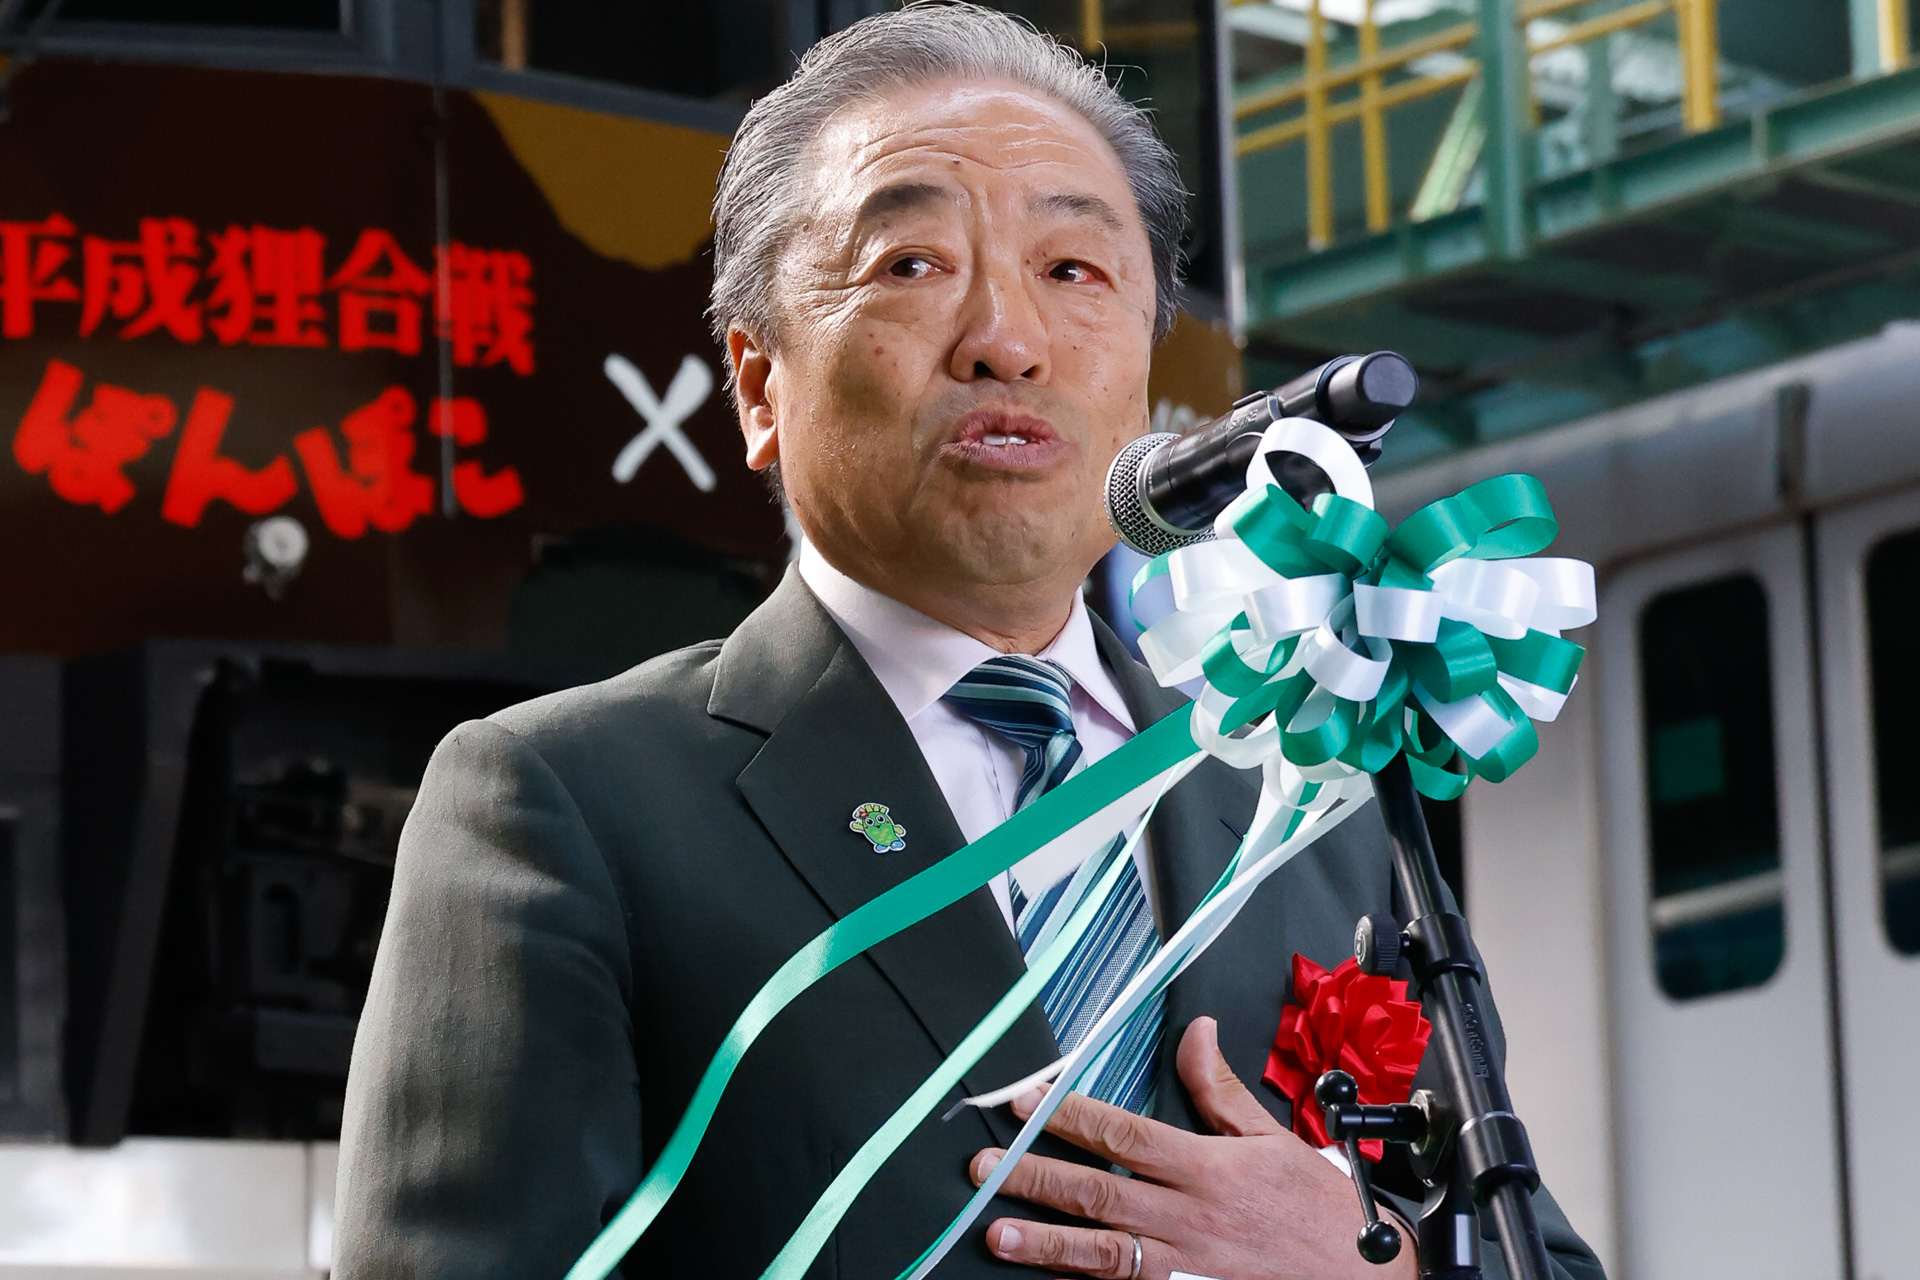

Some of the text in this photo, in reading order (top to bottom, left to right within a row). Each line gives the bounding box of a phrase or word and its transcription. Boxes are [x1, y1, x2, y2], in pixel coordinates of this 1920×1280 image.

[0, 214, 538, 377] 平成狸合戦
[13, 357, 525, 539] ぽんぽこ
